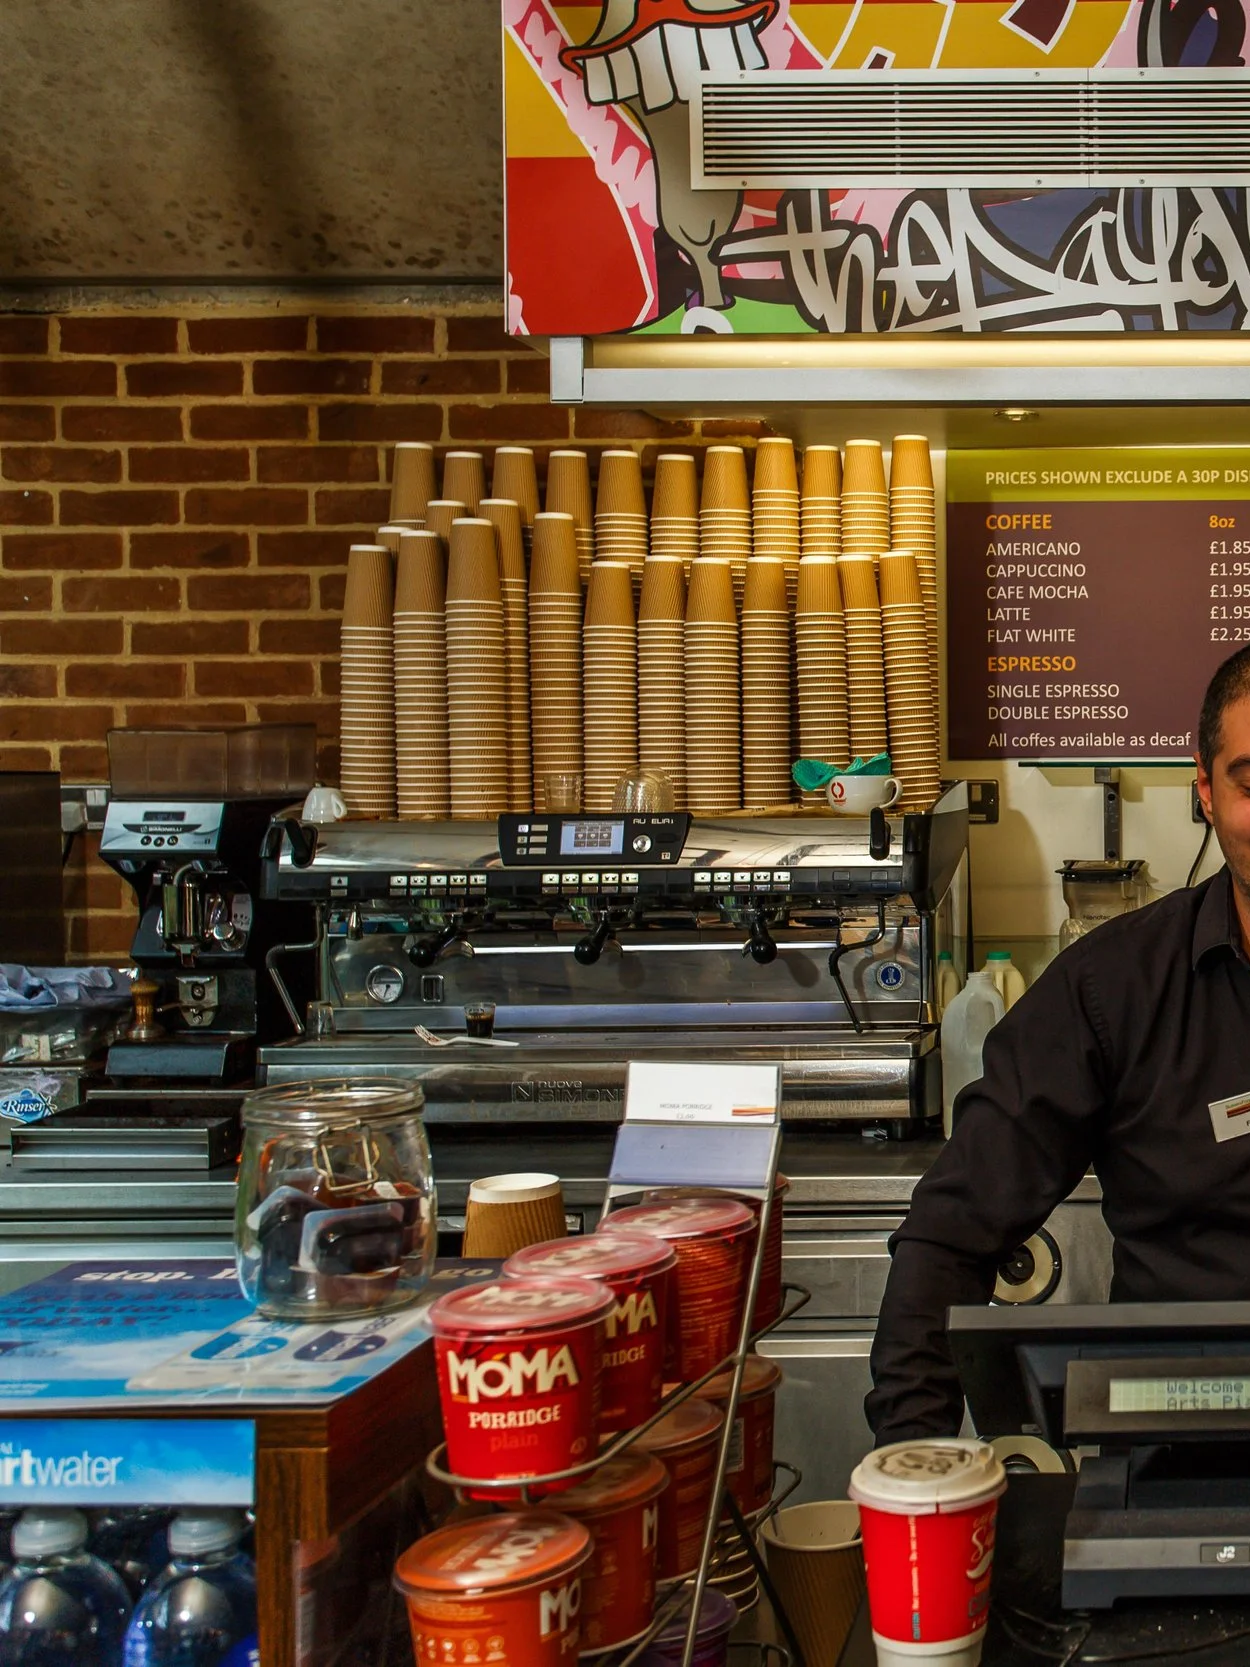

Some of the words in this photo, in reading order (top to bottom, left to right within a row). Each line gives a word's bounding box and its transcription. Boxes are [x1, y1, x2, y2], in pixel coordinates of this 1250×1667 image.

[985, 470, 1037, 485] PRICES
[1040, 470, 1101, 485] SHOWN
[1105, 469, 1173, 484] EXCLUDE
[1175, 469, 1188, 483] A
[1191, 469, 1220, 483] 30P
[985, 513, 1052, 530] COFFEE
[1208, 514, 1235, 528] 8oz
[985, 541, 1081, 556] AMERICANO
[985, 562, 1086, 578] CAPPUCCINO
[986, 585, 1024, 600] CAFE
[1028, 584, 1089, 599] MOCHA
[986, 606, 1031, 621] LATTE
[987, 628, 1022, 643] FLAT
[1024, 628, 1075, 643] WHITE
[987, 655, 1076, 672] ESPRESSO
[987, 683, 1040, 699] SINGLE
[1045, 683, 1120, 698] ESPRESSO
[987, 705, 1049, 720] DOUBLE
[1054, 704, 1129, 720] ESPRESSO
[987, 732, 1007, 747] All
[1010, 731, 1056, 747] coffes
[1059, 731, 1125, 747] available
[1129, 735, 1146, 747] as
[1149, 730, 1191, 746] decaf
[72, 1268, 195, 1283] stop.
[604, 1290, 658, 1338] MA
[602, 1344, 646, 1368] RIDGE
[1166, 1379, 1244, 1394] Welcome
[1166, 1395, 1211, 1411] Arts
[468, 1404, 561, 1430] PORRIDGE
[490, 1430, 539, 1453] plain
